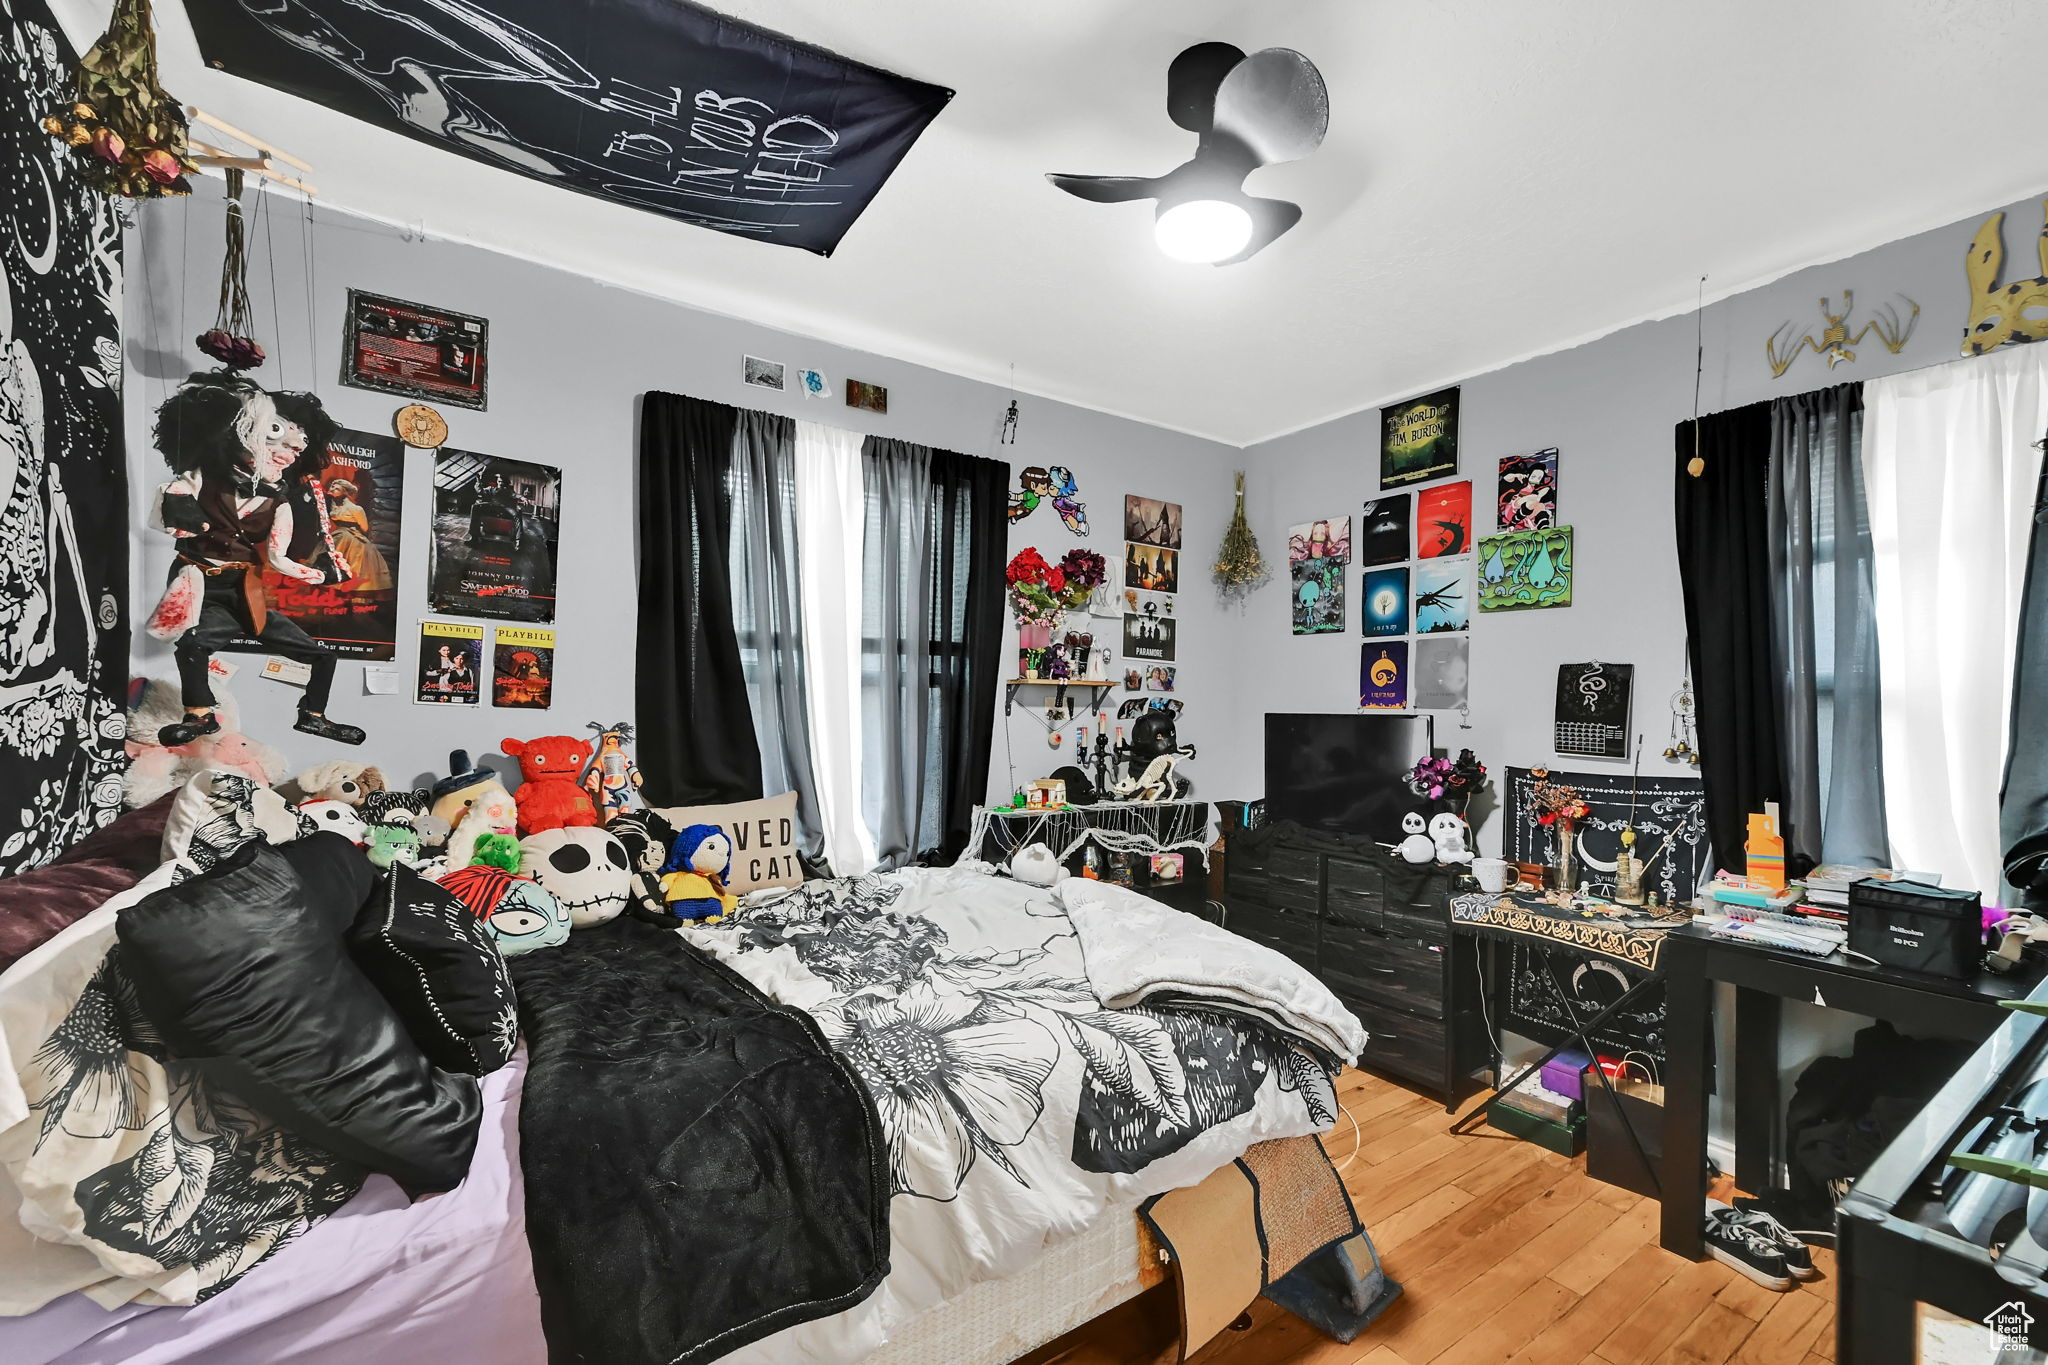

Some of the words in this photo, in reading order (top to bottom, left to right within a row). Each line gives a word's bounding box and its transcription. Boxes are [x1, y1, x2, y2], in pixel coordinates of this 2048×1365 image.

[600, 77, 686, 133] ALL
[685, 88, 775, 158] YOUR
[743, 114, 853, 198] HEAD
[1406, 407, 1437, 426] WORLD
[1389, 431, 1407, 447] TIM
[1411, 421, 1445, 442] BURTON
[326, 442, 376, 458] ANNALEIGH
[331, 456, 372, 470] ASHFORD
[428, 624, 479, 634] PLAYBILL
[498, 629, 553, 641] PLAYBILL
[1135, 647, 1163, 658] PARAMORE
[750, 855, 792, 882] CAT
